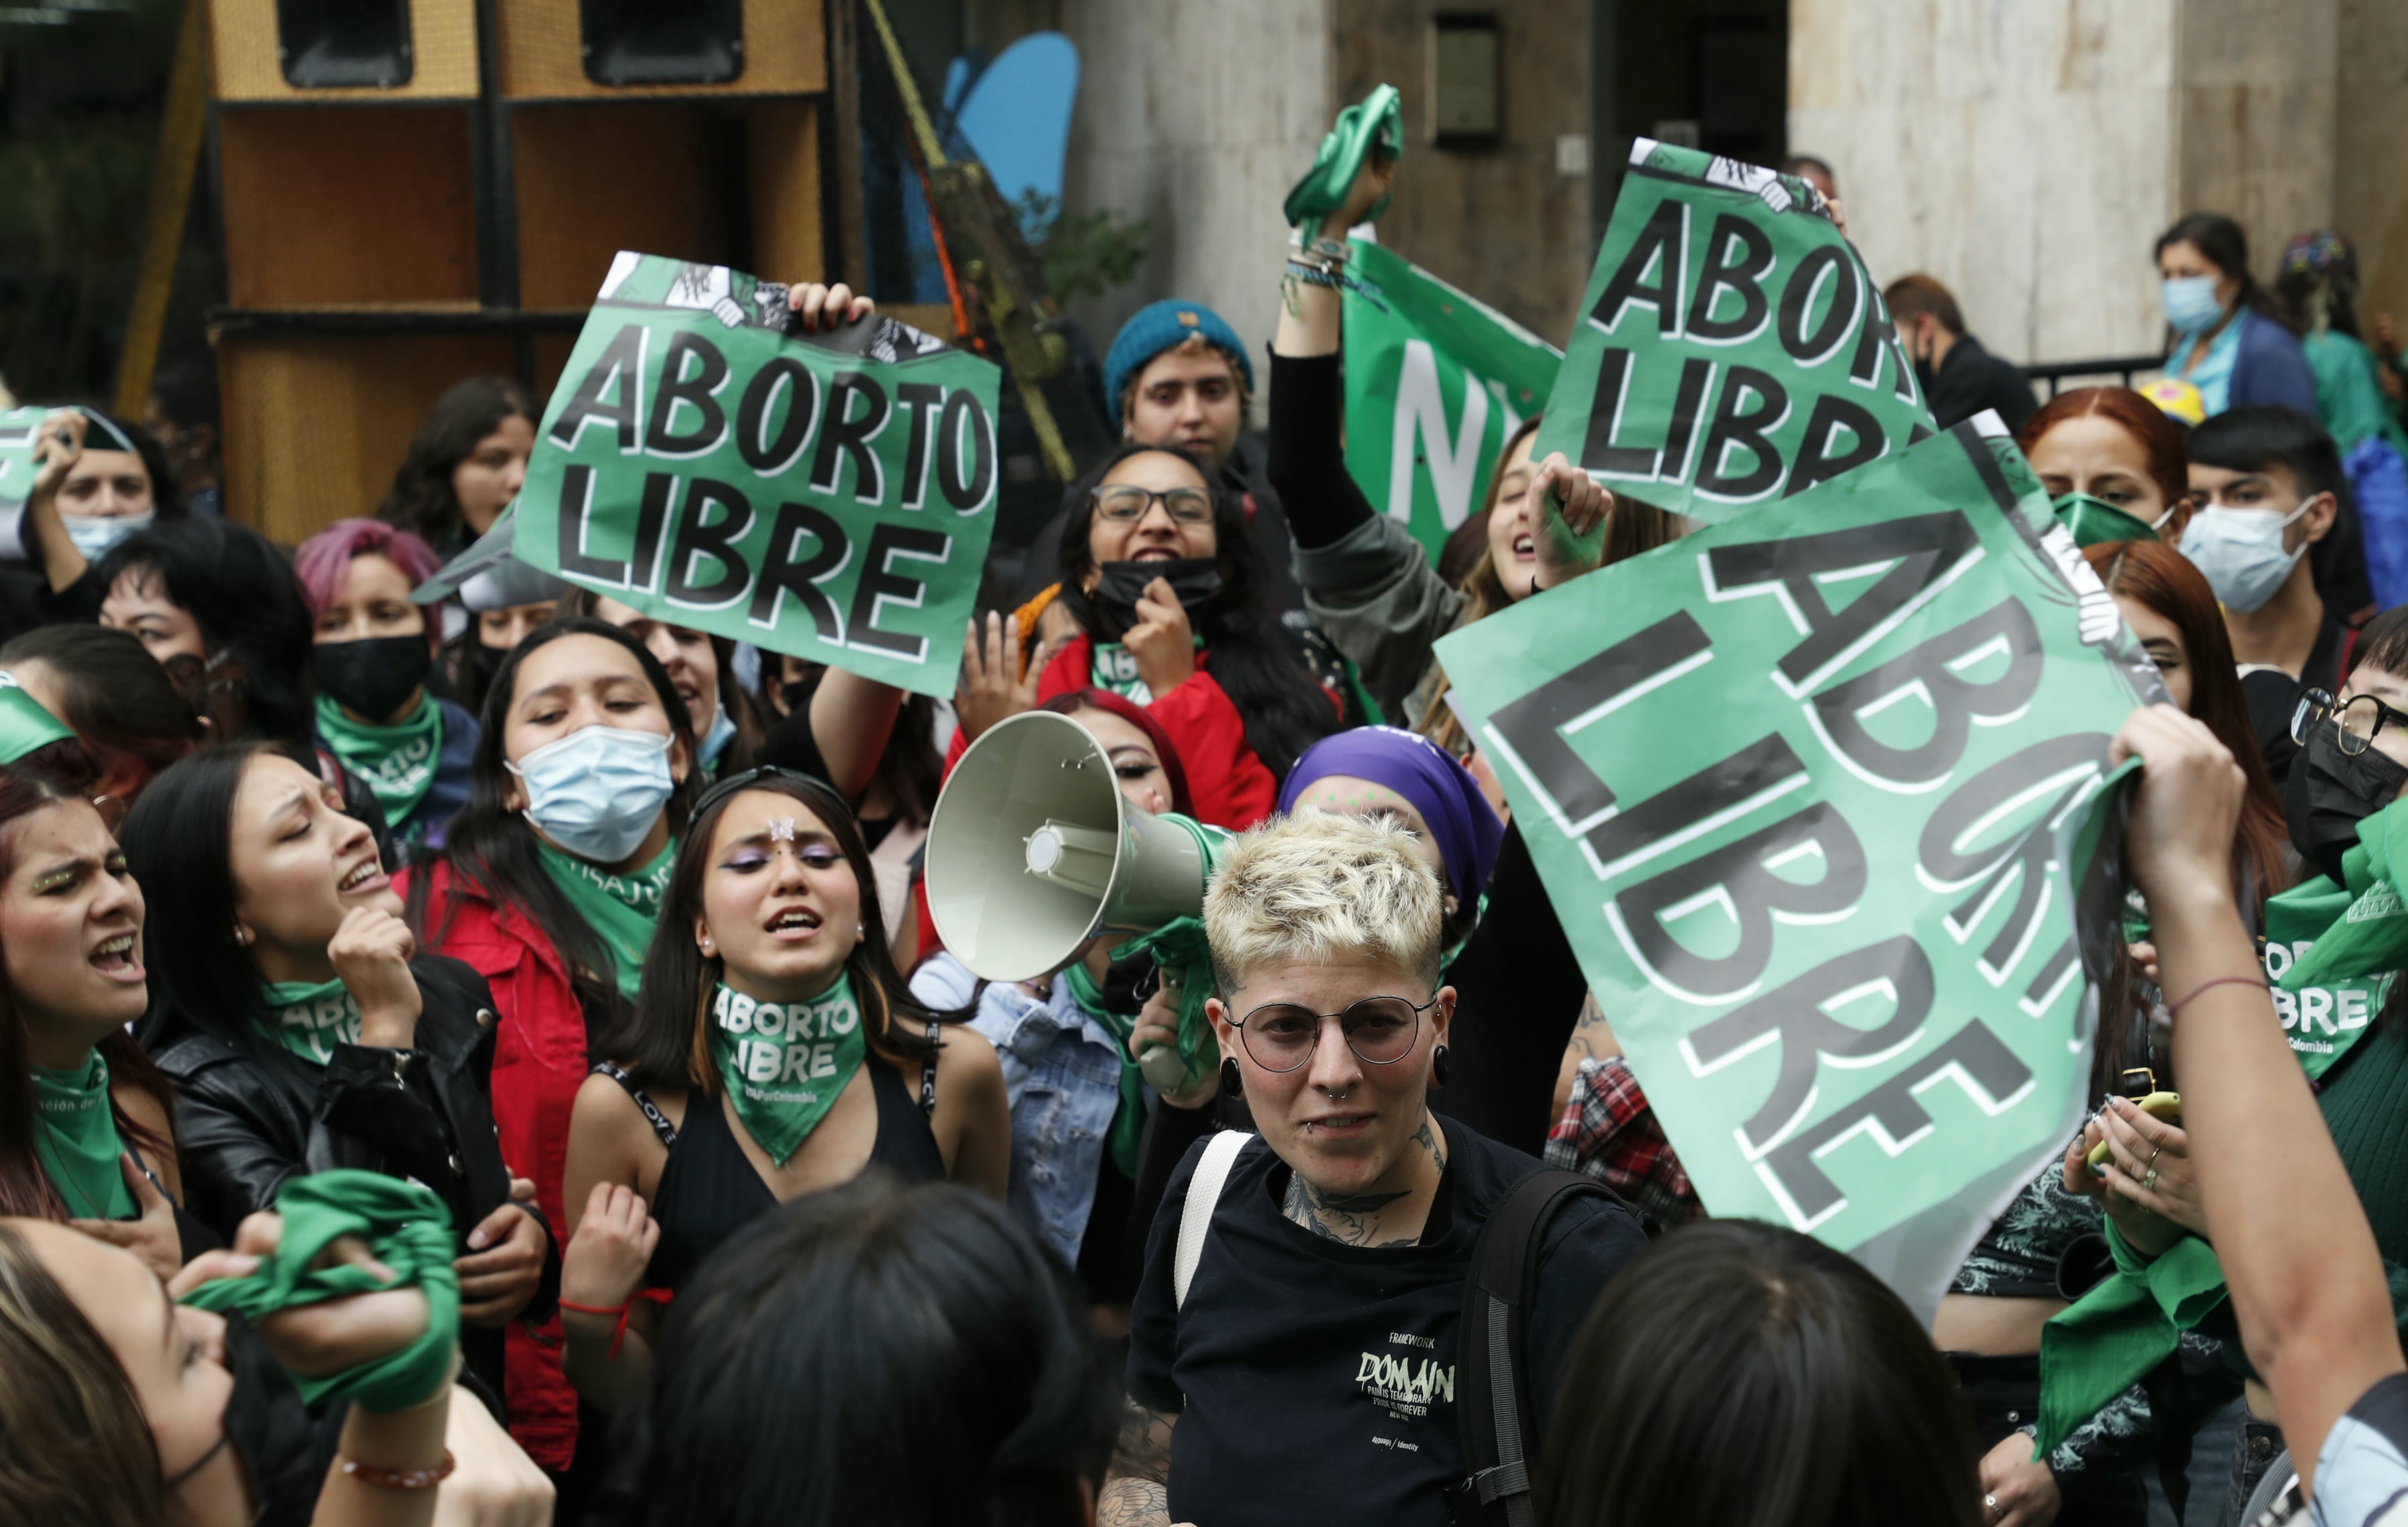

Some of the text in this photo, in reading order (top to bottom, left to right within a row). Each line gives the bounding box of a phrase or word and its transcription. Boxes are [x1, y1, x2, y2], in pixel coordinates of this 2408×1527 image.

[547, 323, 998, 517] ABORTO
[1579, 346, 1938, 505] LIBR
[558, 464, 952, 664] LIBRE
[1482, 608, 2036, 1232] LIBRE
[712, 987, 858, 1042] ABORTO
[2285, 1036, 2334, 1054] Colombia
[633, 1090, 676, 1145] LOVE
[1389, 1332, 1436, 1350] FRAMEWORK
[1355, 1351, 1455, 1403] DOMAIN
[1367, 1385, 1382, 1397] PAIN
[1382, 1388, 1389, 1398] IS
[1373, 1397, 1391, 1409] PRIDE
[1397, 1403, 1427, 1417] FOREVER
